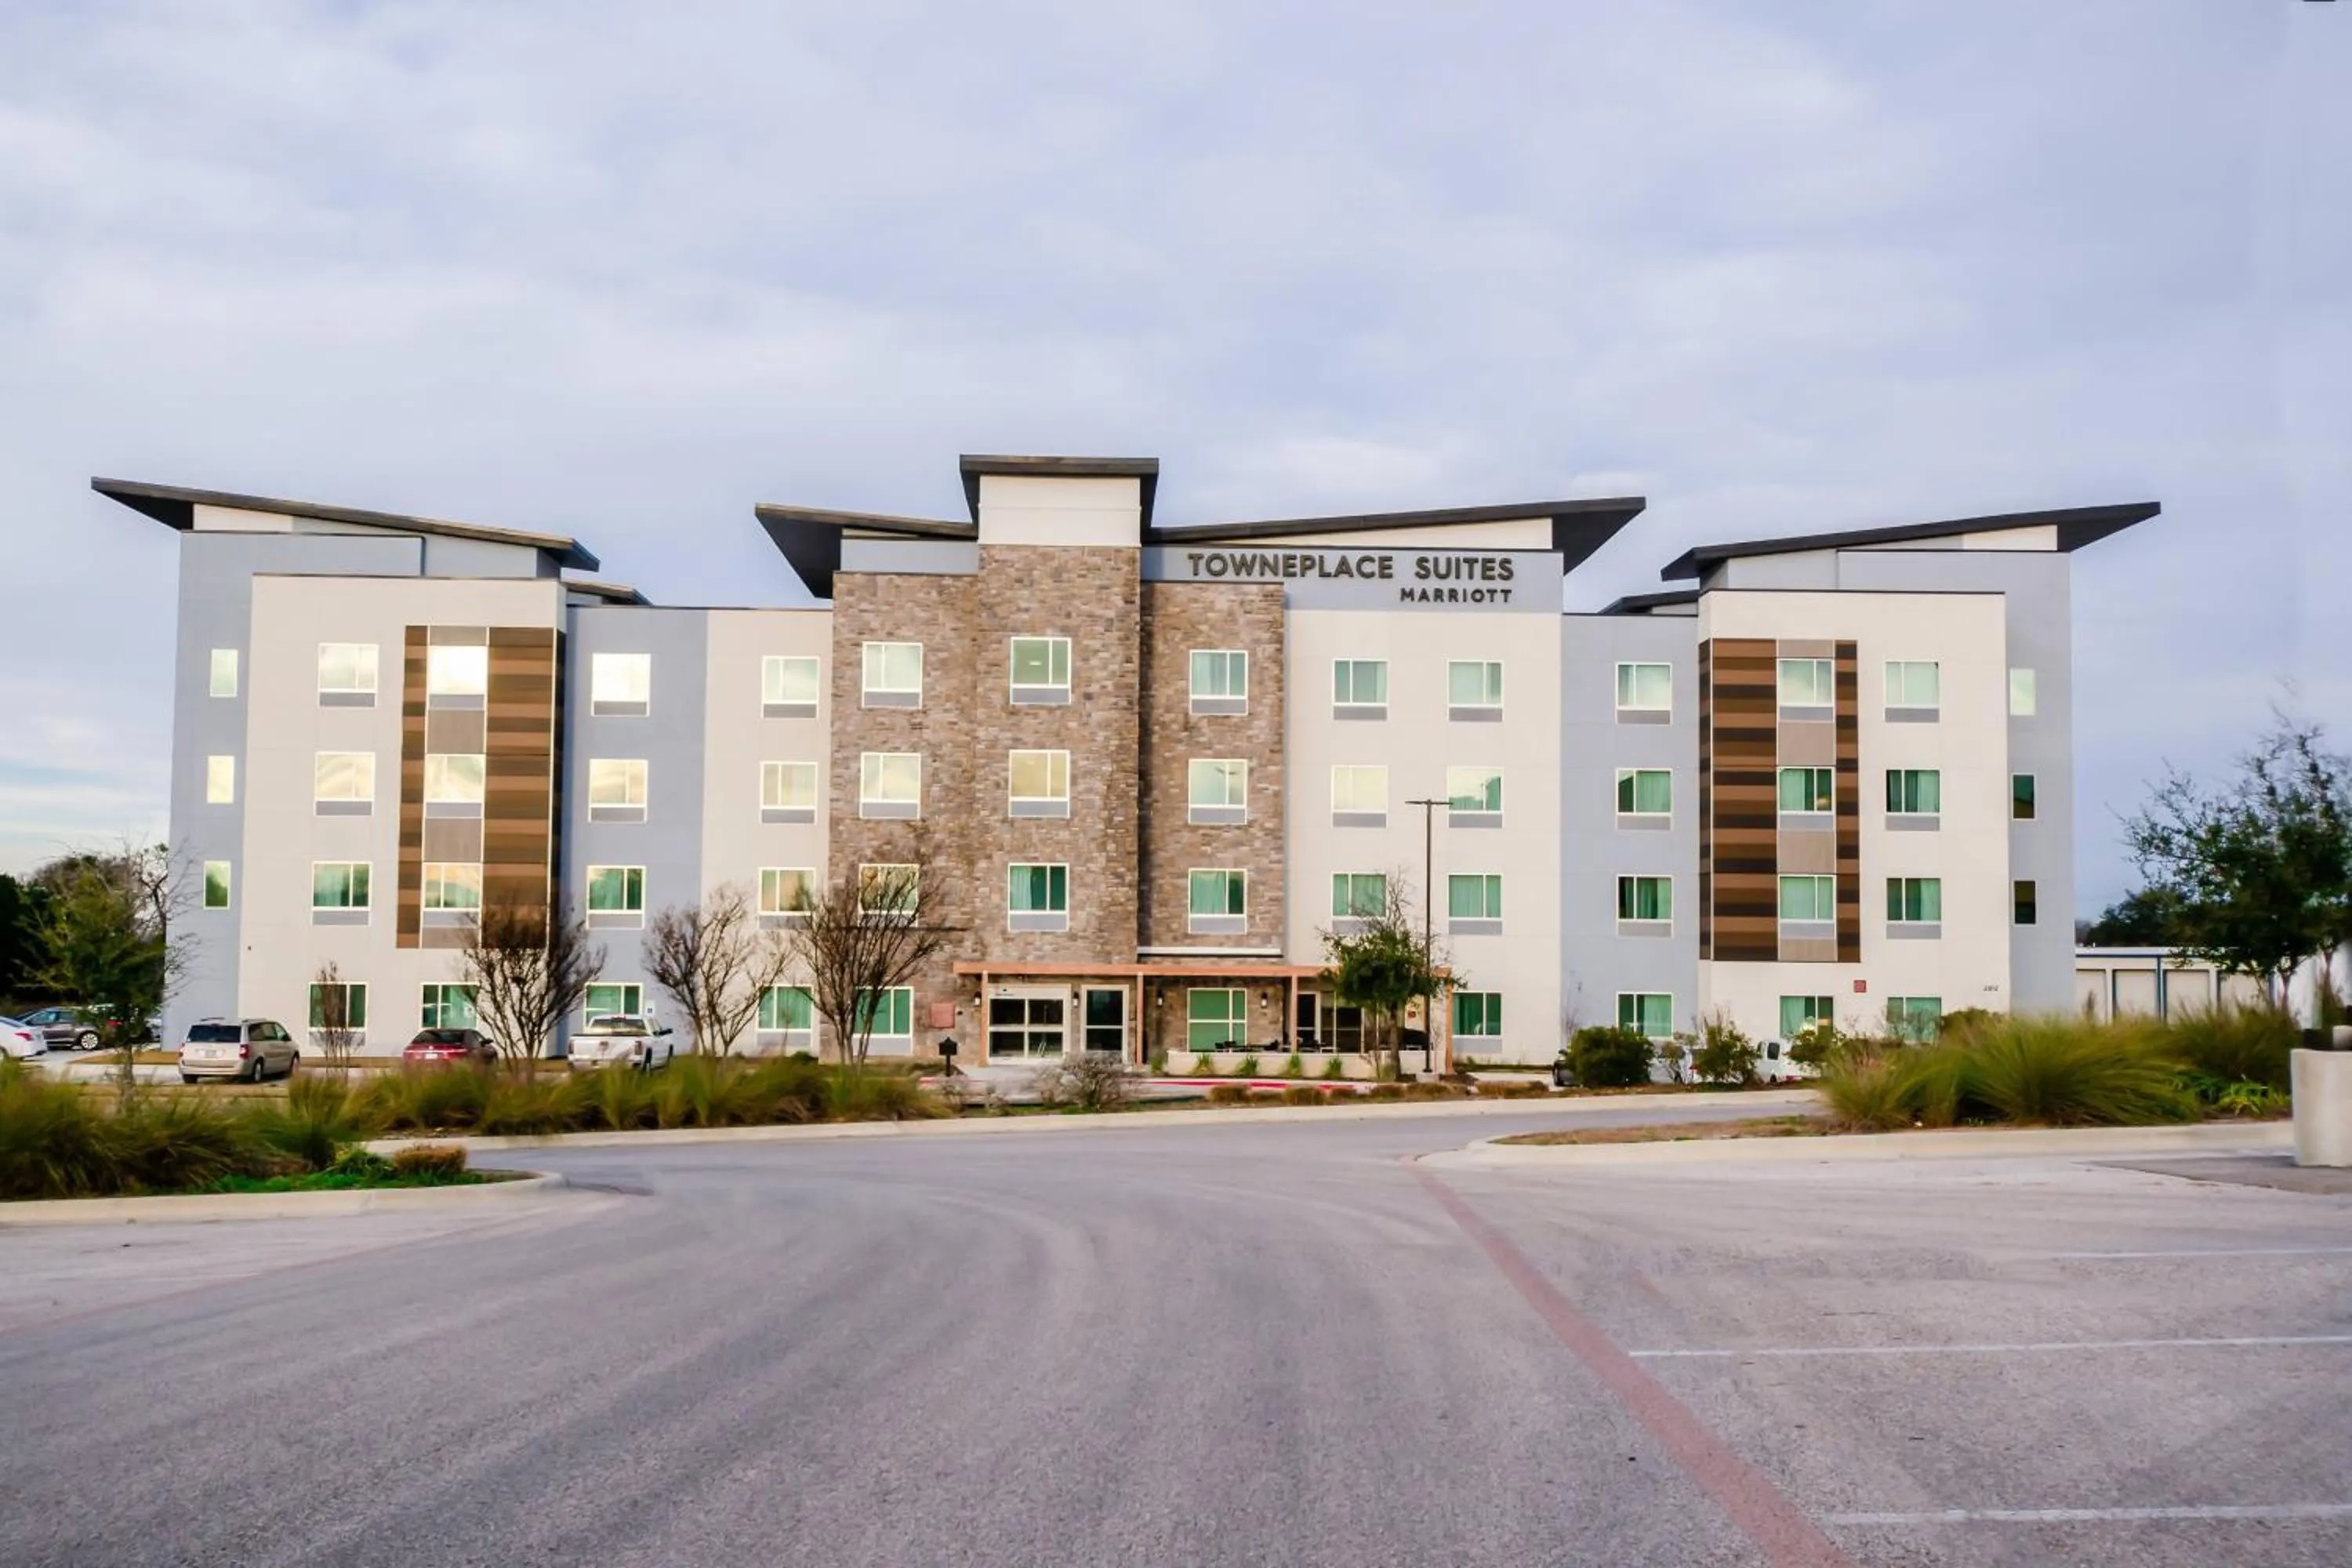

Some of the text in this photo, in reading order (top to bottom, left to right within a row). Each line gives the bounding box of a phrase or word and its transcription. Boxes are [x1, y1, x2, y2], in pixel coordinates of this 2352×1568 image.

[1188, 553, 1514, 581] TOWNEPLACE SUITES
[1400, 587, 1512, 603] MARRIOTT
